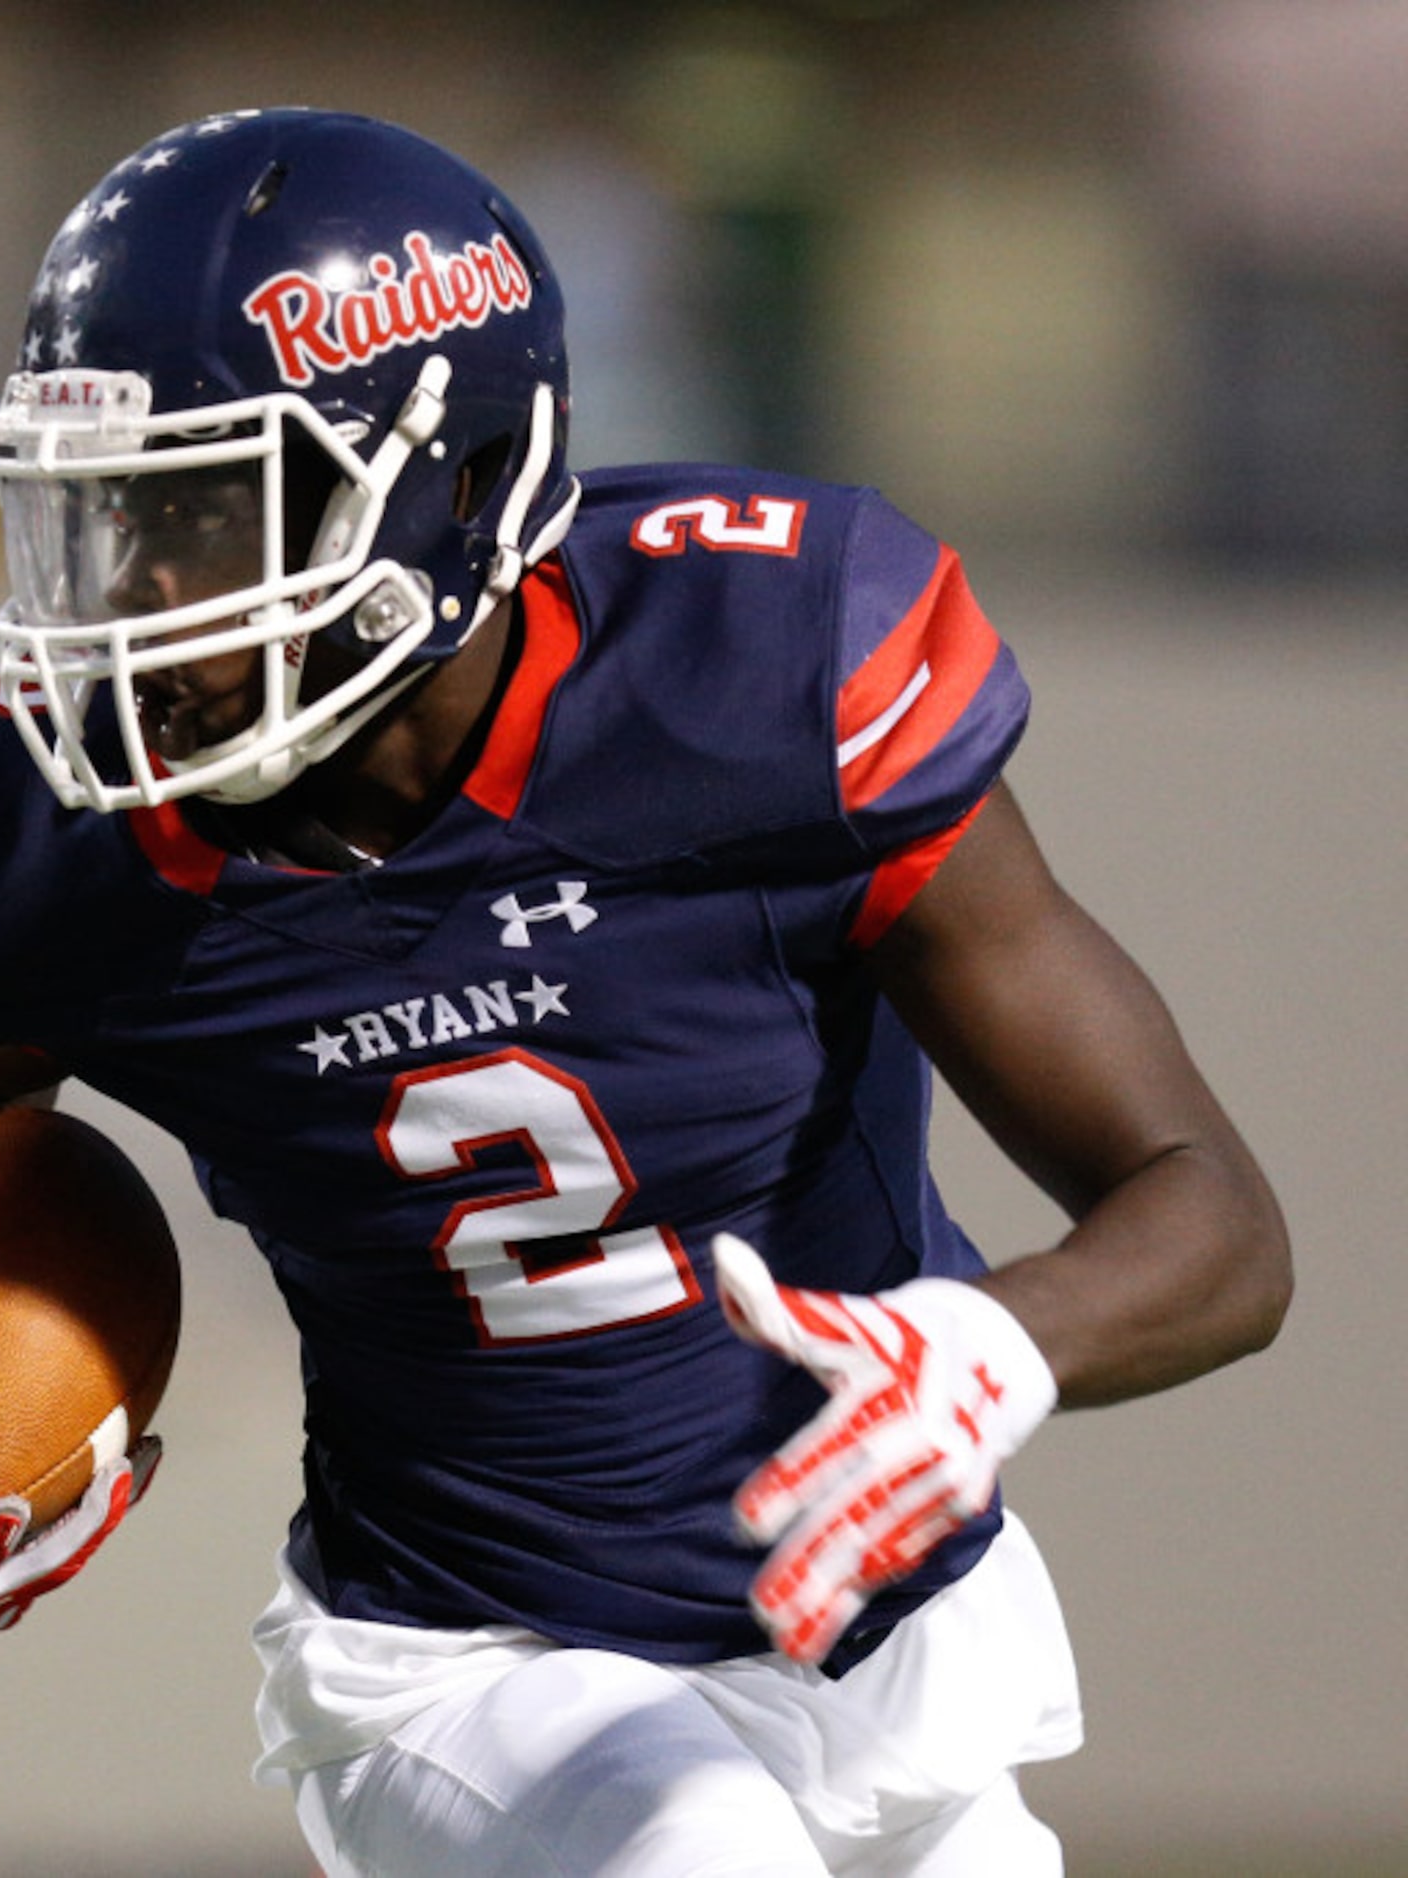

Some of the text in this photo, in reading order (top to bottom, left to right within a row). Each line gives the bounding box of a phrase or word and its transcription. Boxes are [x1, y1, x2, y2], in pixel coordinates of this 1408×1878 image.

[242, 231, 531, 387] Raiders
[629, 493, 809, 559] 2
[342, 980, 520, 1062] RYAN
[373, 1046, 705, 1349] 2
